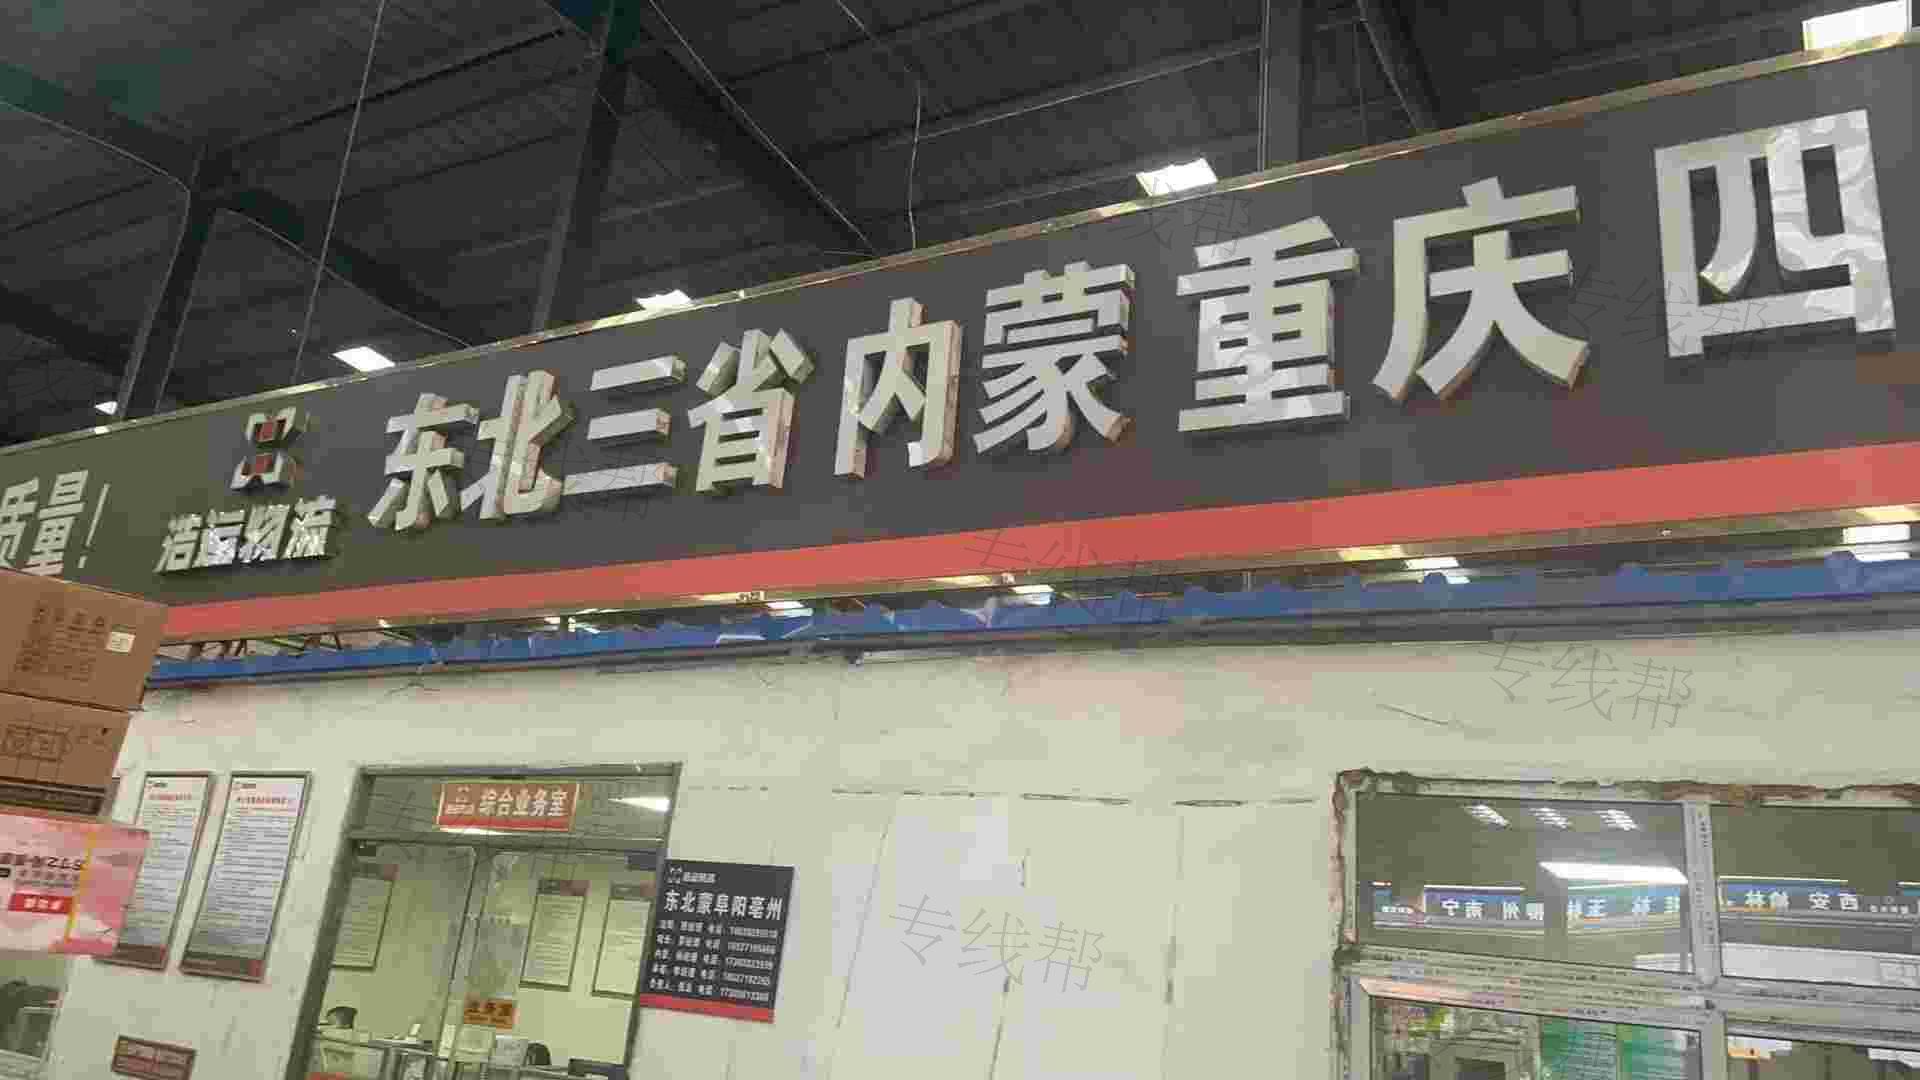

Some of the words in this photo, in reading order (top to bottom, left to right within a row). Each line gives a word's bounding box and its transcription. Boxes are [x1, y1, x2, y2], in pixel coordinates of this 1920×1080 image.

[367, 327, 812, 531] 东北三省
[834, 260, 1135, 479] 内蒙
[1176, 175, 1589, 433] 重庆
[1653, 109, 1897, 359] 四
[152, 495, 337, 575] 浩运物流
[479, 784, 569, 817] 综合业务室
